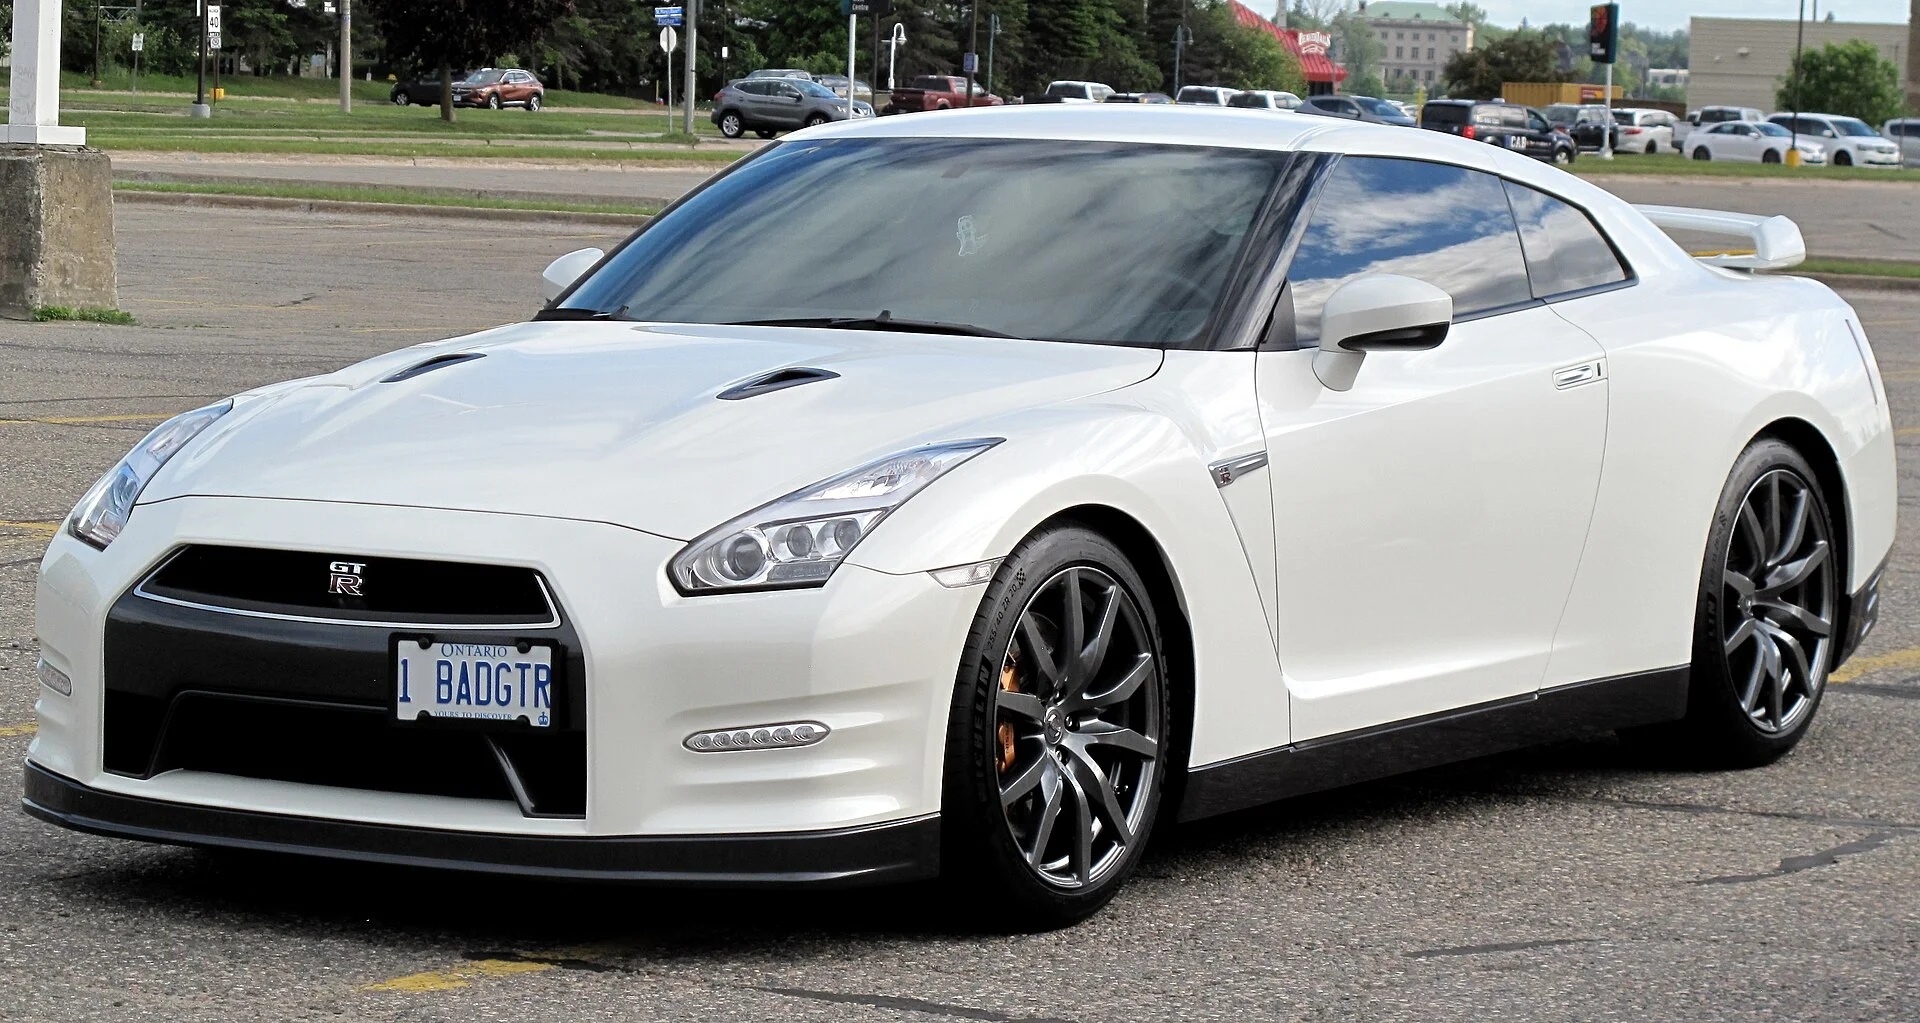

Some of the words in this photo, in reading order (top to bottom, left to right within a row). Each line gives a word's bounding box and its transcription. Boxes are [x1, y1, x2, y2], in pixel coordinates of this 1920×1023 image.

[209, 16, 219, 28] 40
[1510, 135, 1527, 149] CAB
[330, 561, 366, 575] GT
[328, 573, 363, 596] R
[399, 658, 412, 703] 1
[436, 659, 551, 709] BADGTR
[474, 712, 513, 720] DISCOVER
